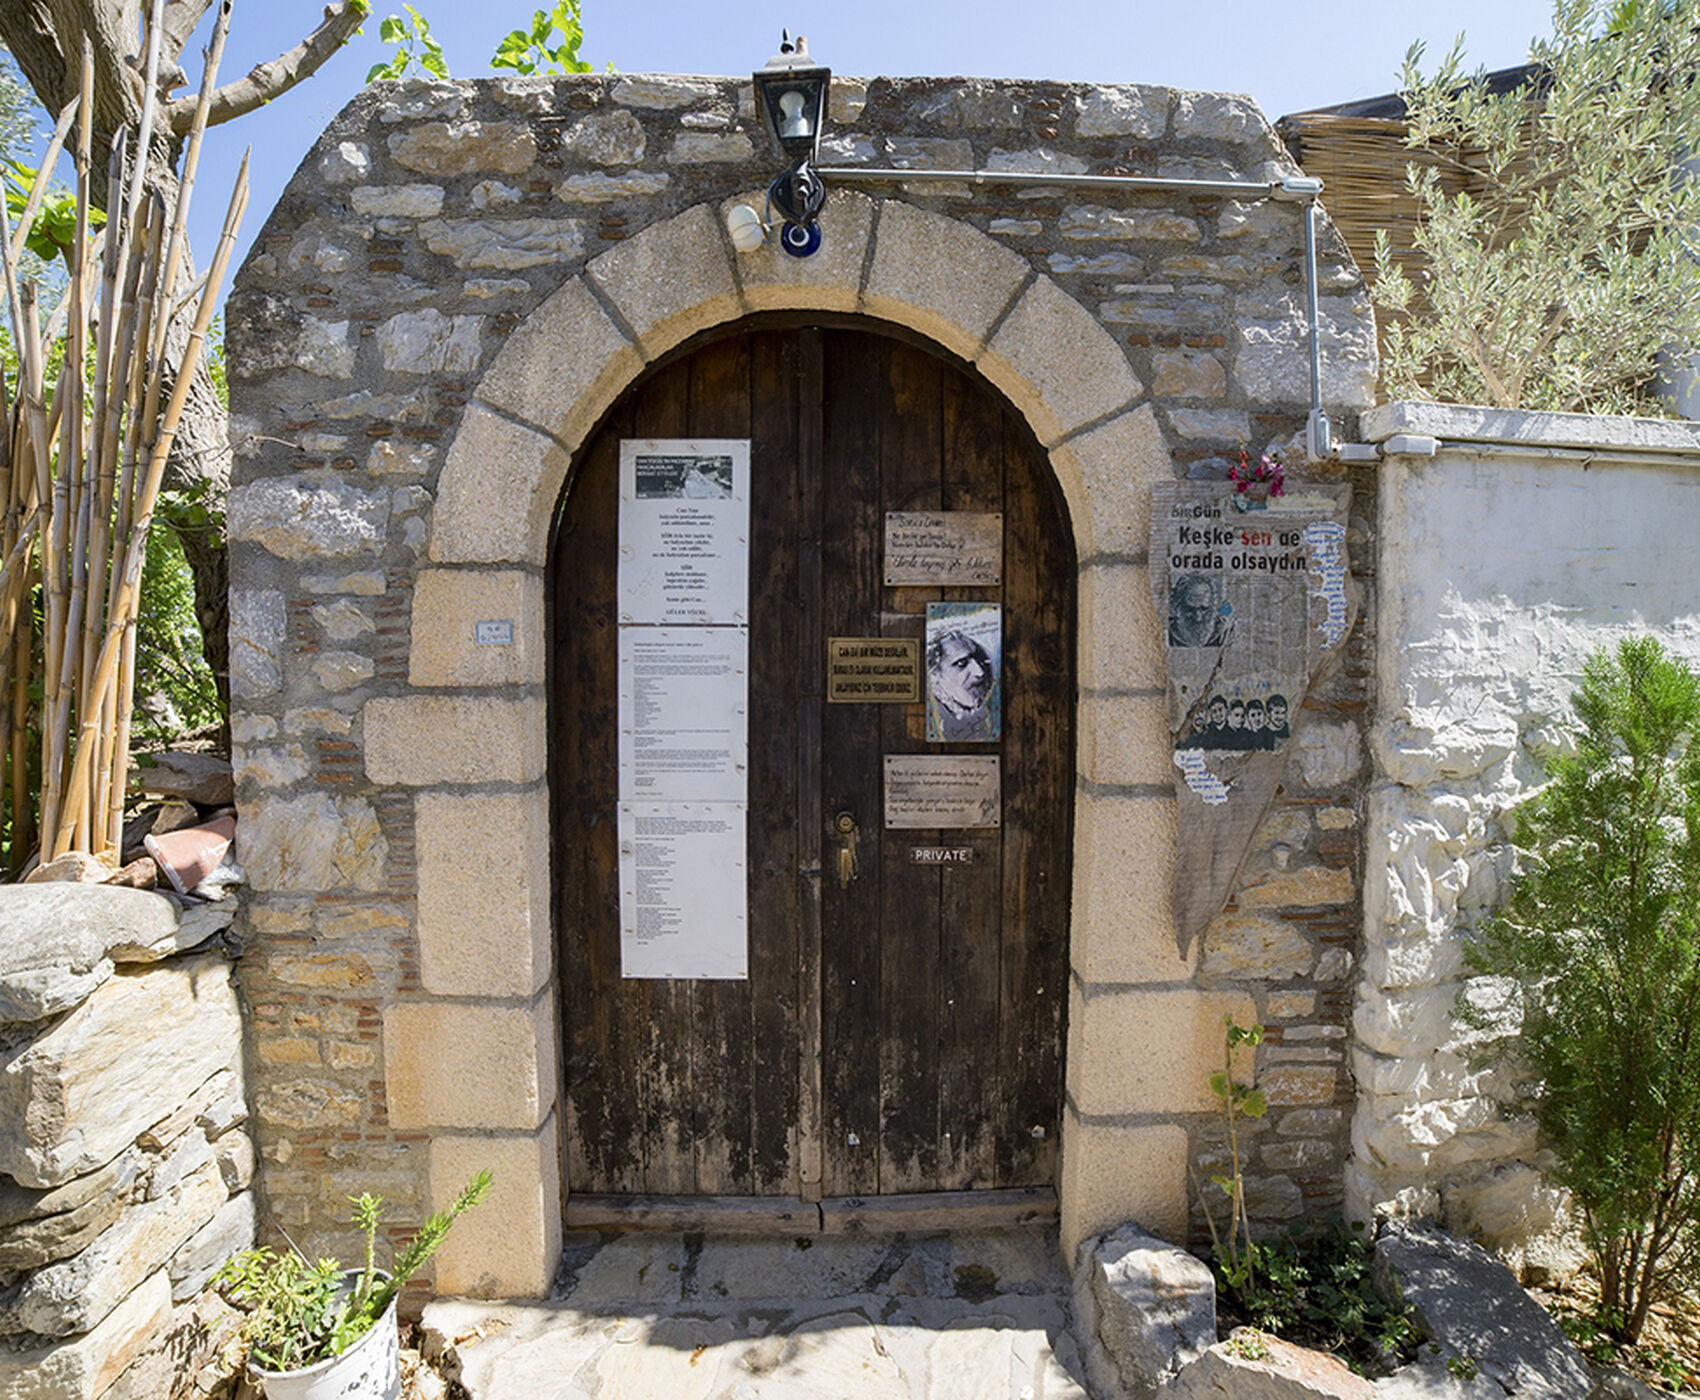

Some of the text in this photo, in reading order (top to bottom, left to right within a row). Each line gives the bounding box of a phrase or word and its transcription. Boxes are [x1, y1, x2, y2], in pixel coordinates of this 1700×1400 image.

[1179, 525, 1233, 549] Keşke
[1172, 551, 1306, 574] orada olsaydın
[915, 849, 967, 861] PRIVATE
